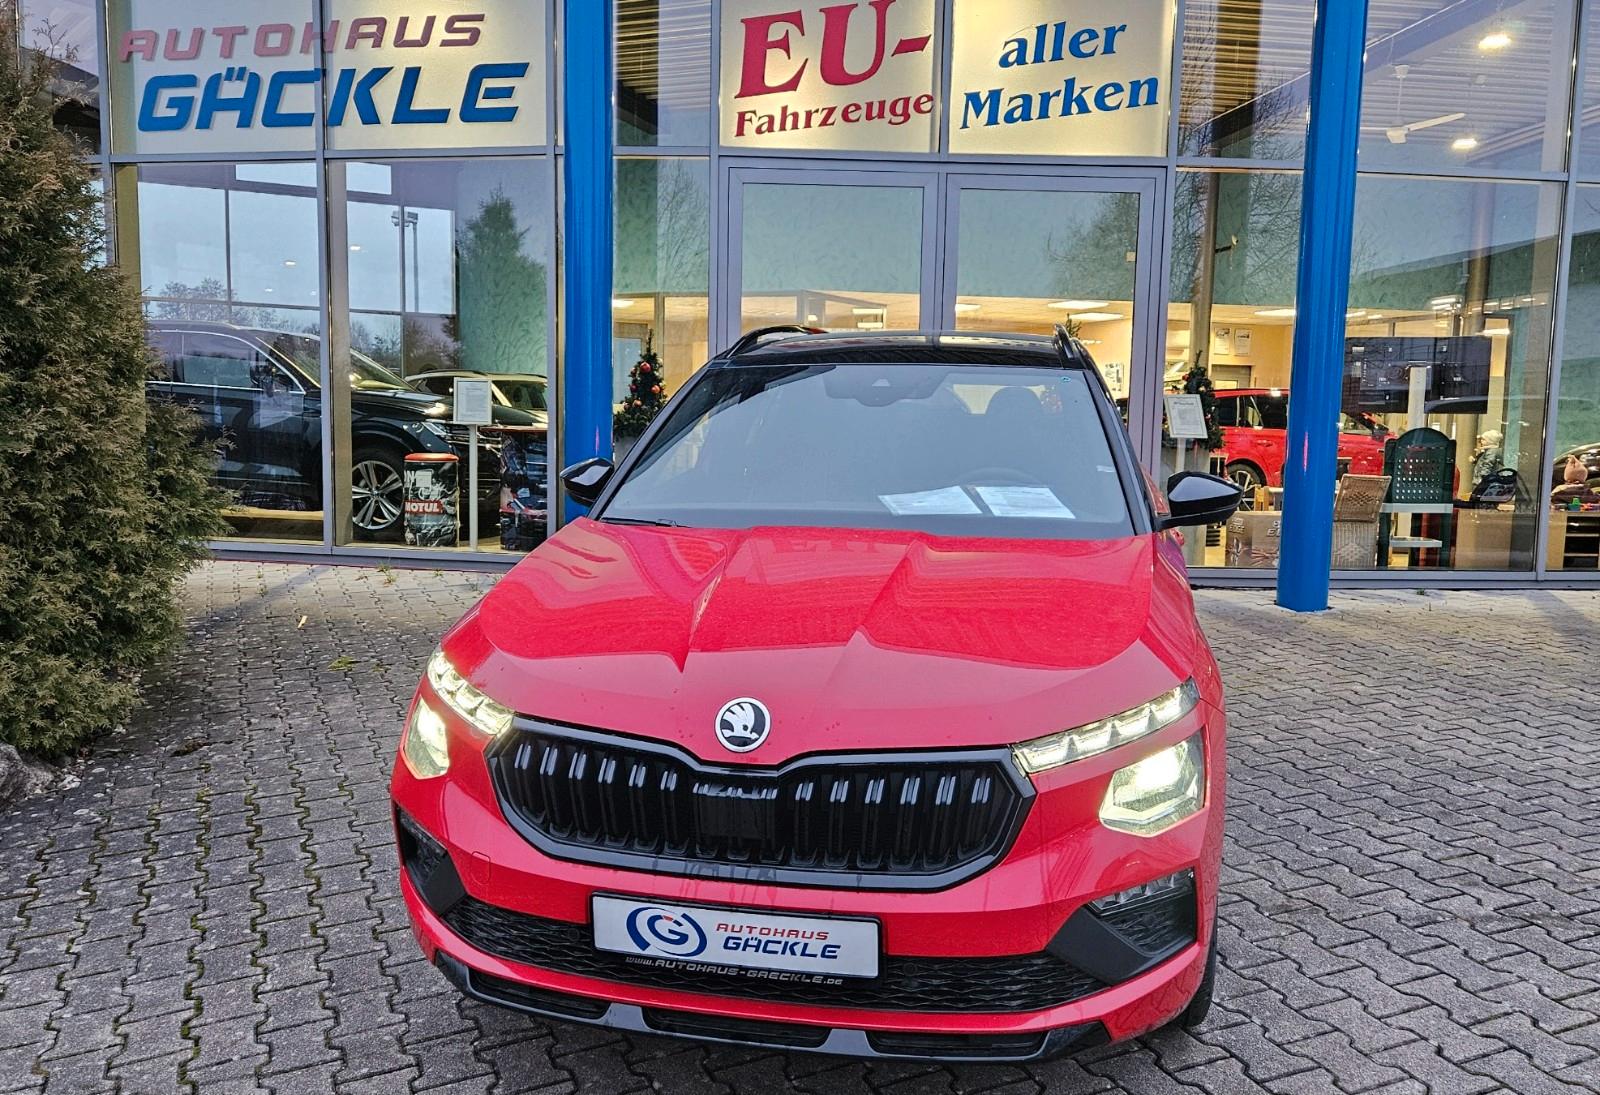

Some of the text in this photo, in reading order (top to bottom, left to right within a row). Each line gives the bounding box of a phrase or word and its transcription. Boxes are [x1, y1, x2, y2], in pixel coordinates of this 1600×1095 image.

[119, 13, 485, 62] AUTOHAUS
[734, 0, 932, 98] EU-
[999, 20, 1127, 69] aller
[138, 62, 530, 131] GÄCKLE
[734, 93, 934, 137] Fahrzeuge
[959, 76, 1159, 129] Marken
[716, 922, 830, 940] AUTOHAUS
[722, 936, 842, 960] GÄCKLE
